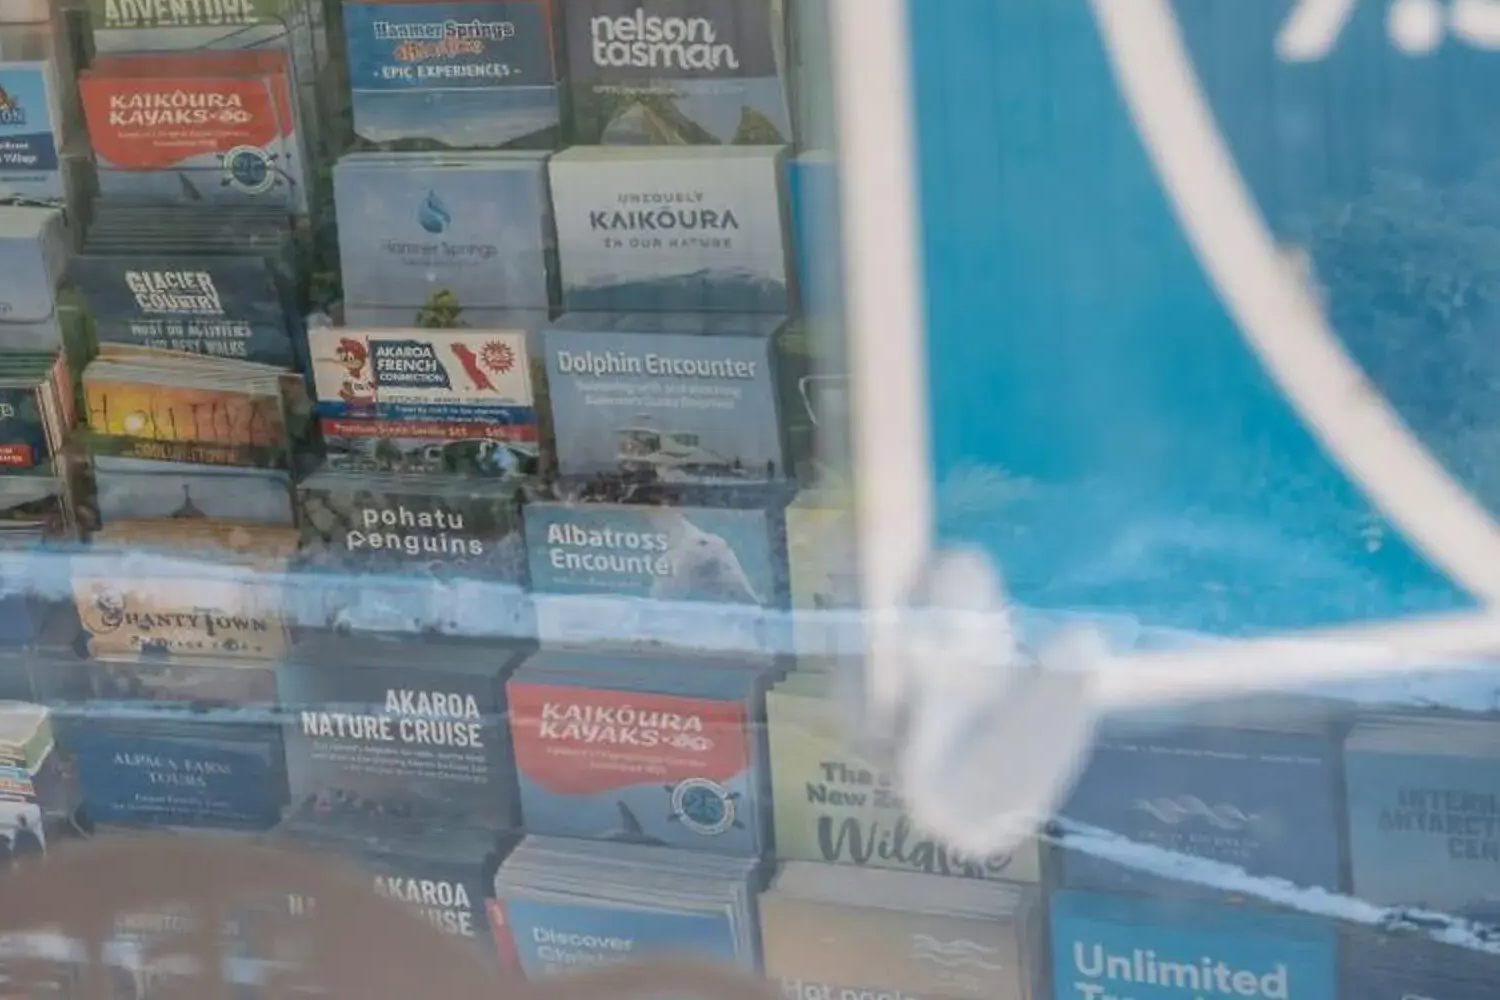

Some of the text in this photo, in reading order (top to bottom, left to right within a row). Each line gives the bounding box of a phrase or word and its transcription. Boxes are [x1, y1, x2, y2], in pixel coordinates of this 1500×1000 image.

[374, 20, 514, 42] Hanmer Springs
[590, 8, 717, 55] nelson
[592, 36, 739, 72] tasman
[382, 63, 510, 79] EPIC EXPERIENCES
[108, 108, 208, 126] KAYAKS
[590, 205, 739, 232] KAIKŌURA
[630, 237, 662, 249] OUR
[125, 270, 217, 293] GLACIER
[134, 292, 224, 314] COUNTRY
[376, 346, 432, 358] AKAROA
[558, 351, 757, 378] Dolphin Encounter
[377, 359, 437, 371] FRENCH
[379, 372, 445, 382] CONNECTION
[361, 506, 465, 530] pohatu
[547, 523, 669, 552] Albatross
[549, 548, 679, 576] Encounter
[385, 688, 480, 719] AKAROA
[301, 711, 484, 748] NATURE CRUISE
[539, 722, 660, 748] KAYAKS
[820, 761, 872, 785] The
[806, 781, 867, 806] New
[533, 926, 635, 953] Discover
[1073, 940, 1289, 999] Unlimited
